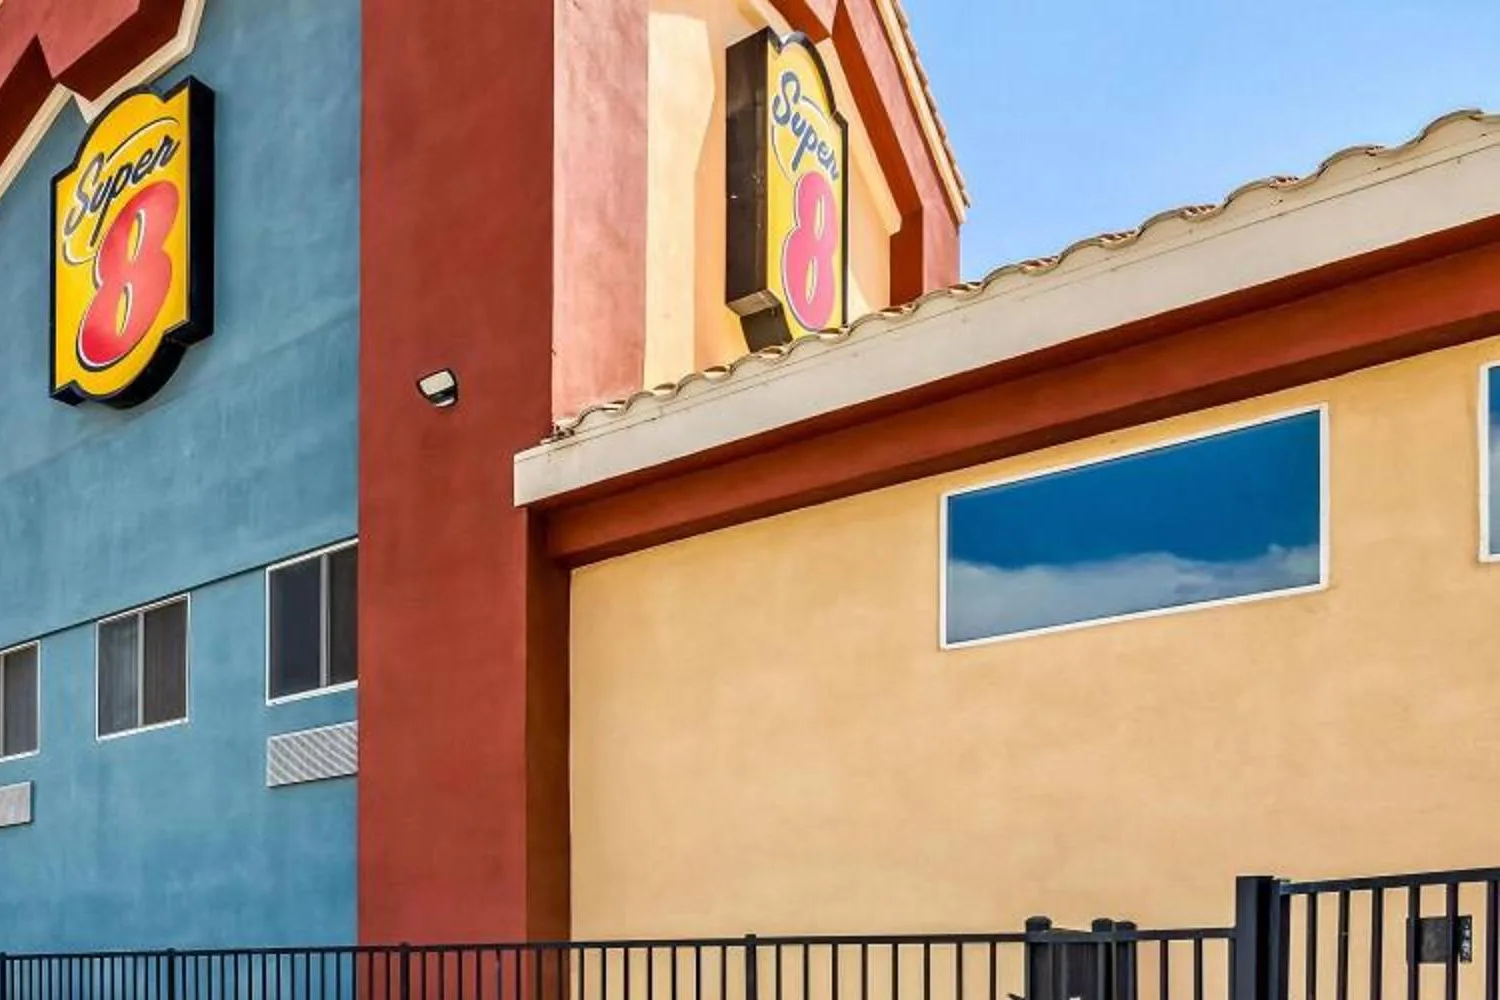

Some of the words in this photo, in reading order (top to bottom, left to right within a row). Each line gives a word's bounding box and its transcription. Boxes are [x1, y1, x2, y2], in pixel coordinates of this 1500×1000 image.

[63, 136, 181, 249] Super
[771, 71, 841, 182] Super
[77, 181, 181, 371] 8
[782, 171, 838, 331] 8
